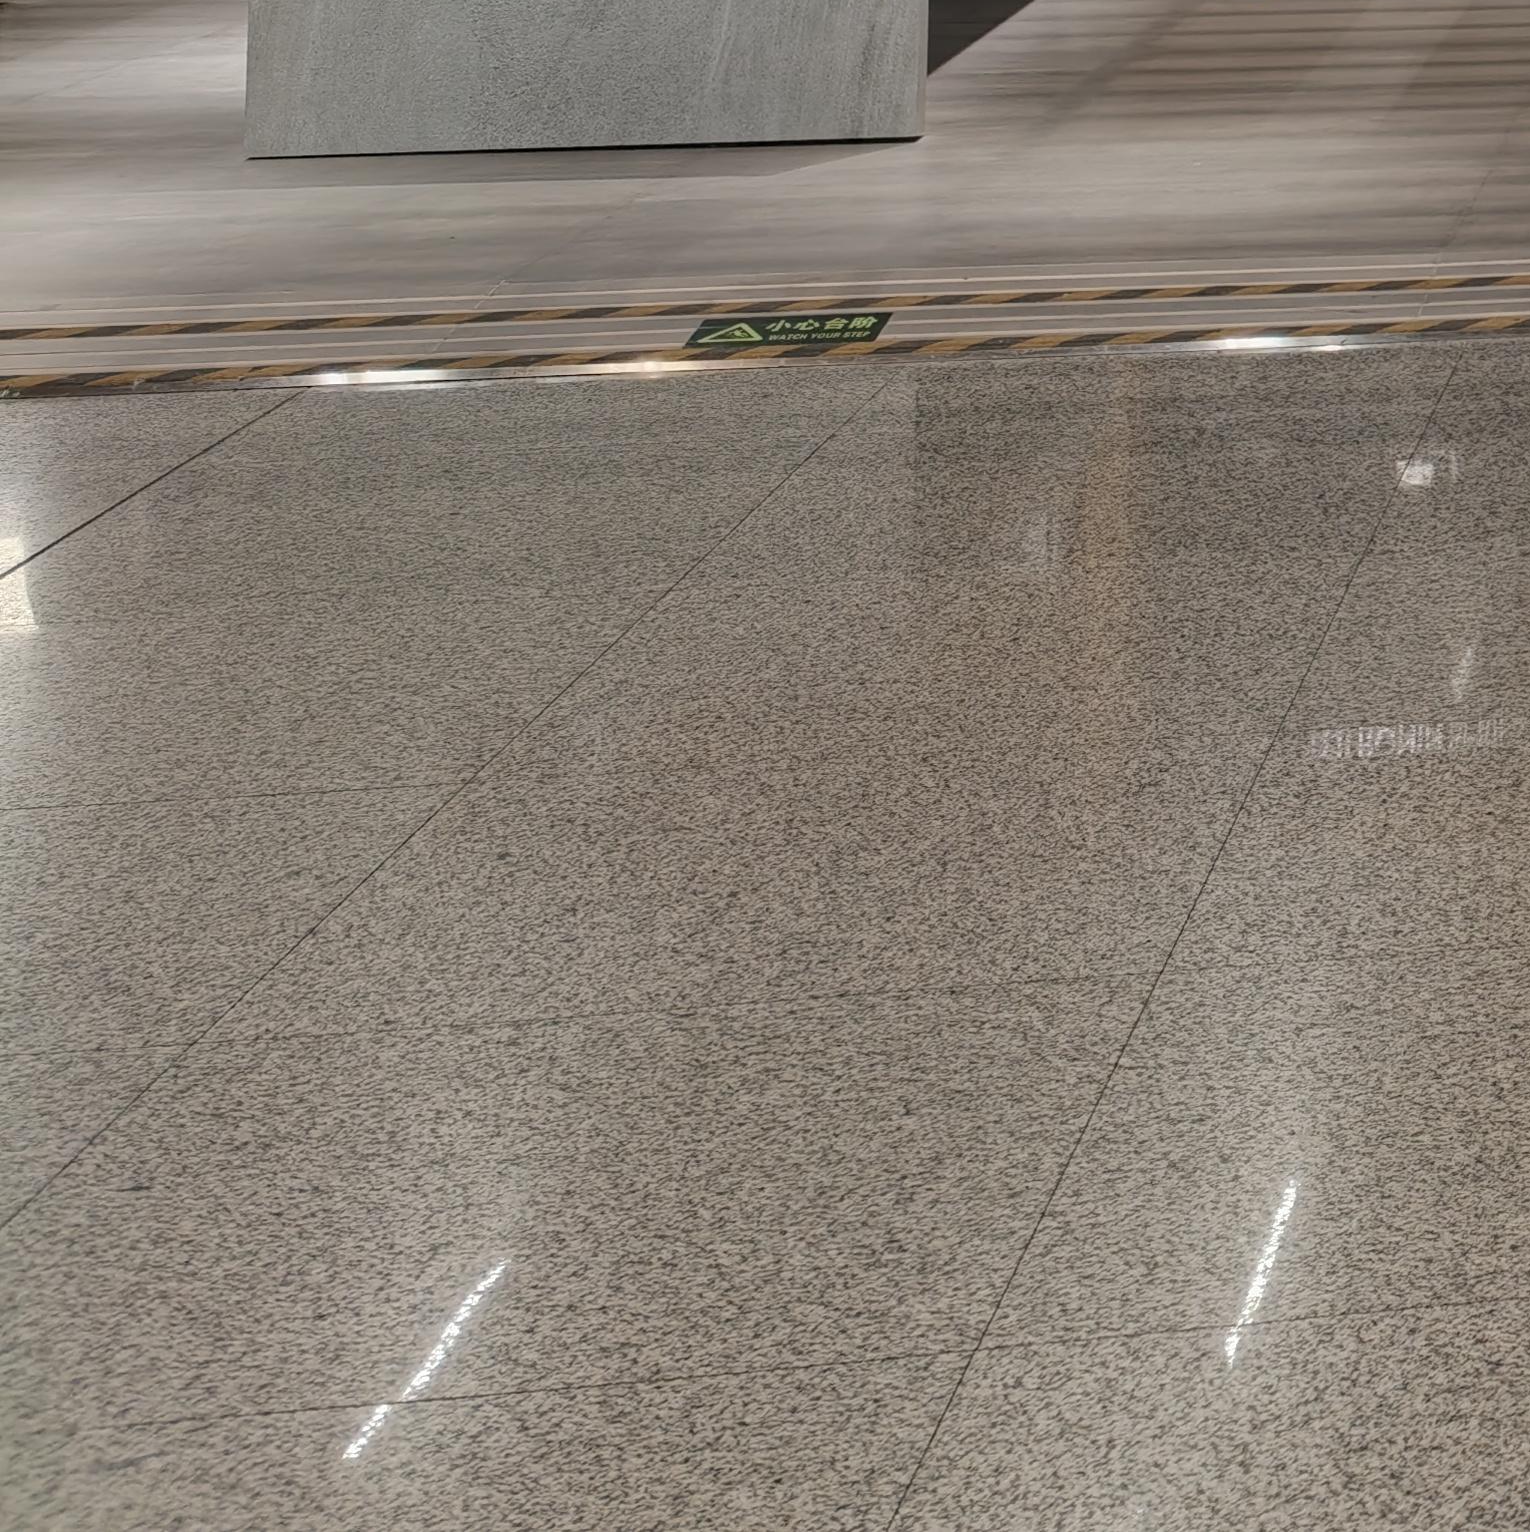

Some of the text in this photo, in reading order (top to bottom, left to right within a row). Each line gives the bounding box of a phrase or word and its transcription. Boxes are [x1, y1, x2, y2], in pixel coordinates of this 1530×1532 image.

[765, 316, 878, 332] 小心台阶
[768, 333, 808, 341] WATCH
[811, 331, 841, 339] YOUR
